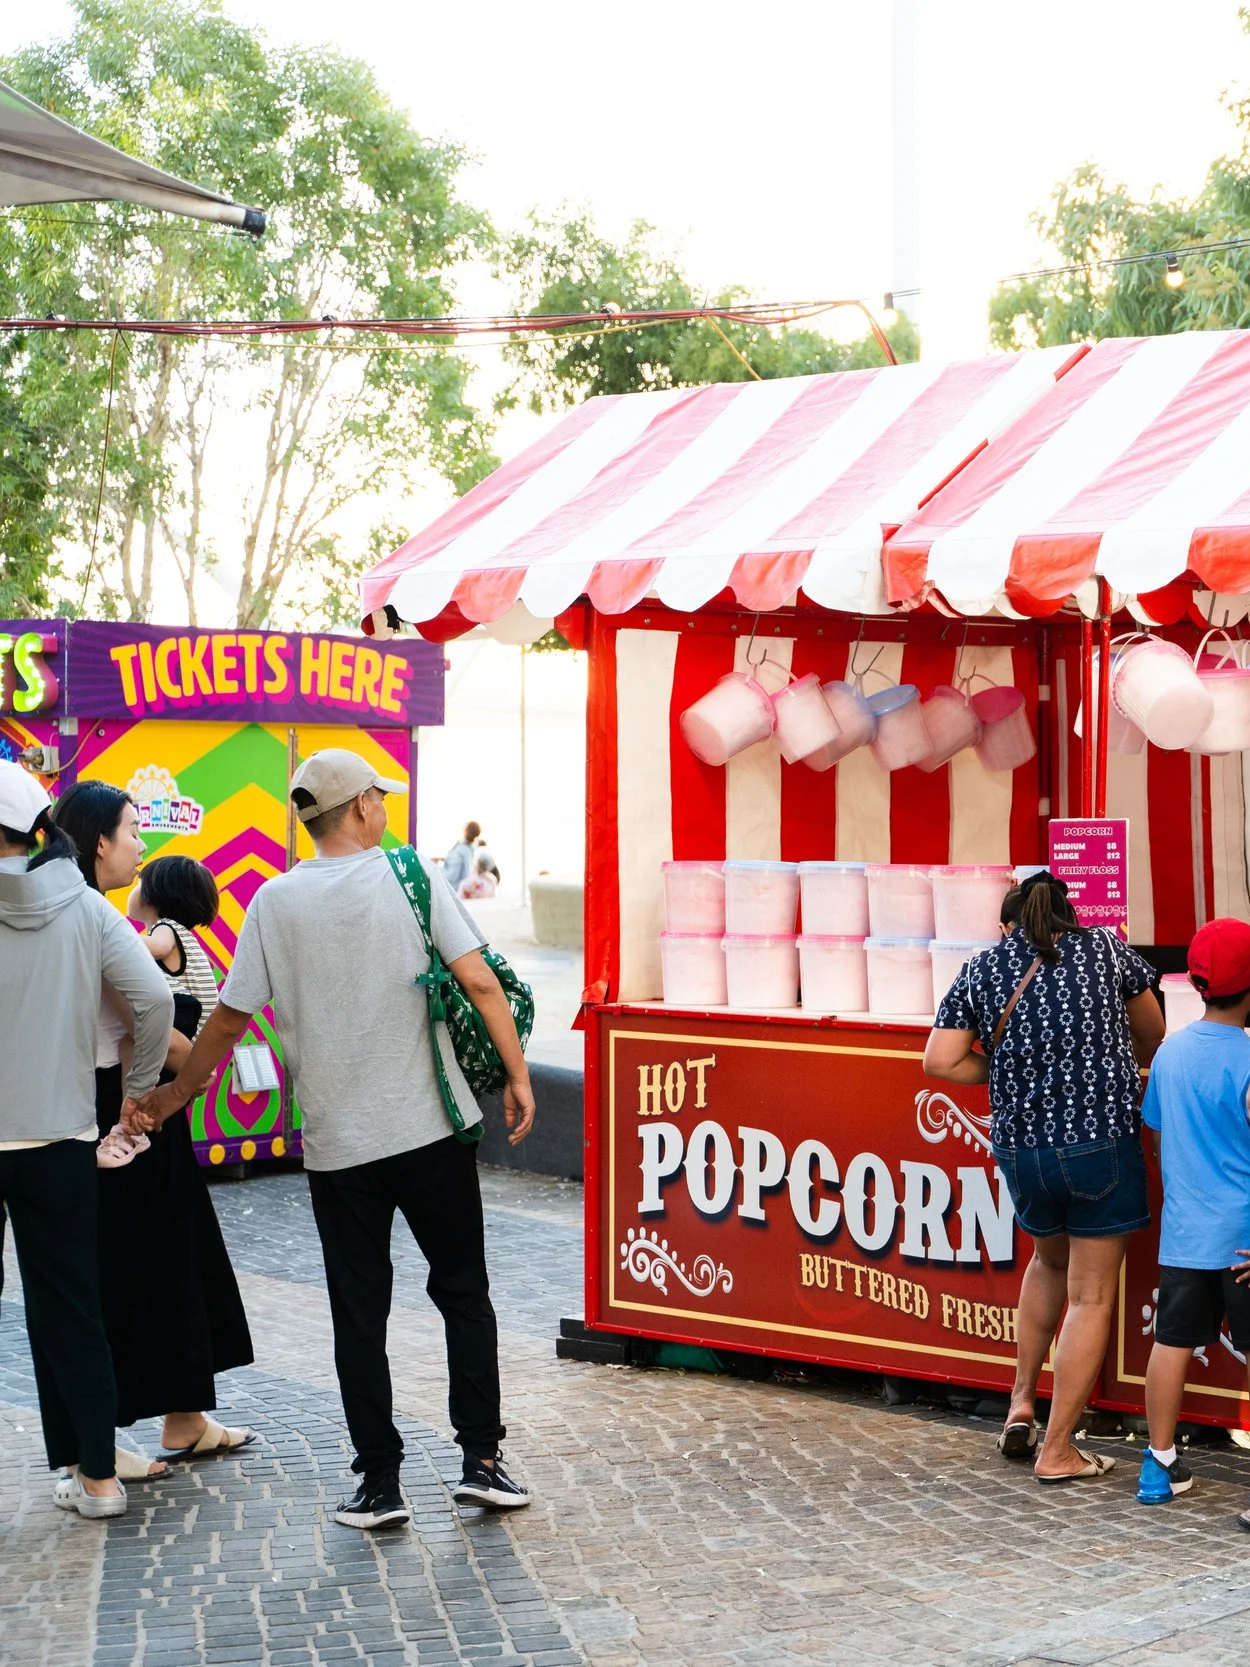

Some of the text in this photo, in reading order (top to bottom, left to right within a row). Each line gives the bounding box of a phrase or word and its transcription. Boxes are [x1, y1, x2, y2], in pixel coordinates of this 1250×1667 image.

[110, 634, 408, 713] TICKETS HERE
[134, 799, 200, 829] RNIVAL
[1064, 827, 1113, 836] POPCORN
[1107, 842, 1117, 850] $8
[1059, 865, 1119, 875] FAIRY FLOSS
[1107, 881, 1117, 889] $8
[637, 1054, 715, 1115] HOT
[638, 1120, 1016, 1262] POPCORN
[800, 1253, 930, 1319] BUTTERED
